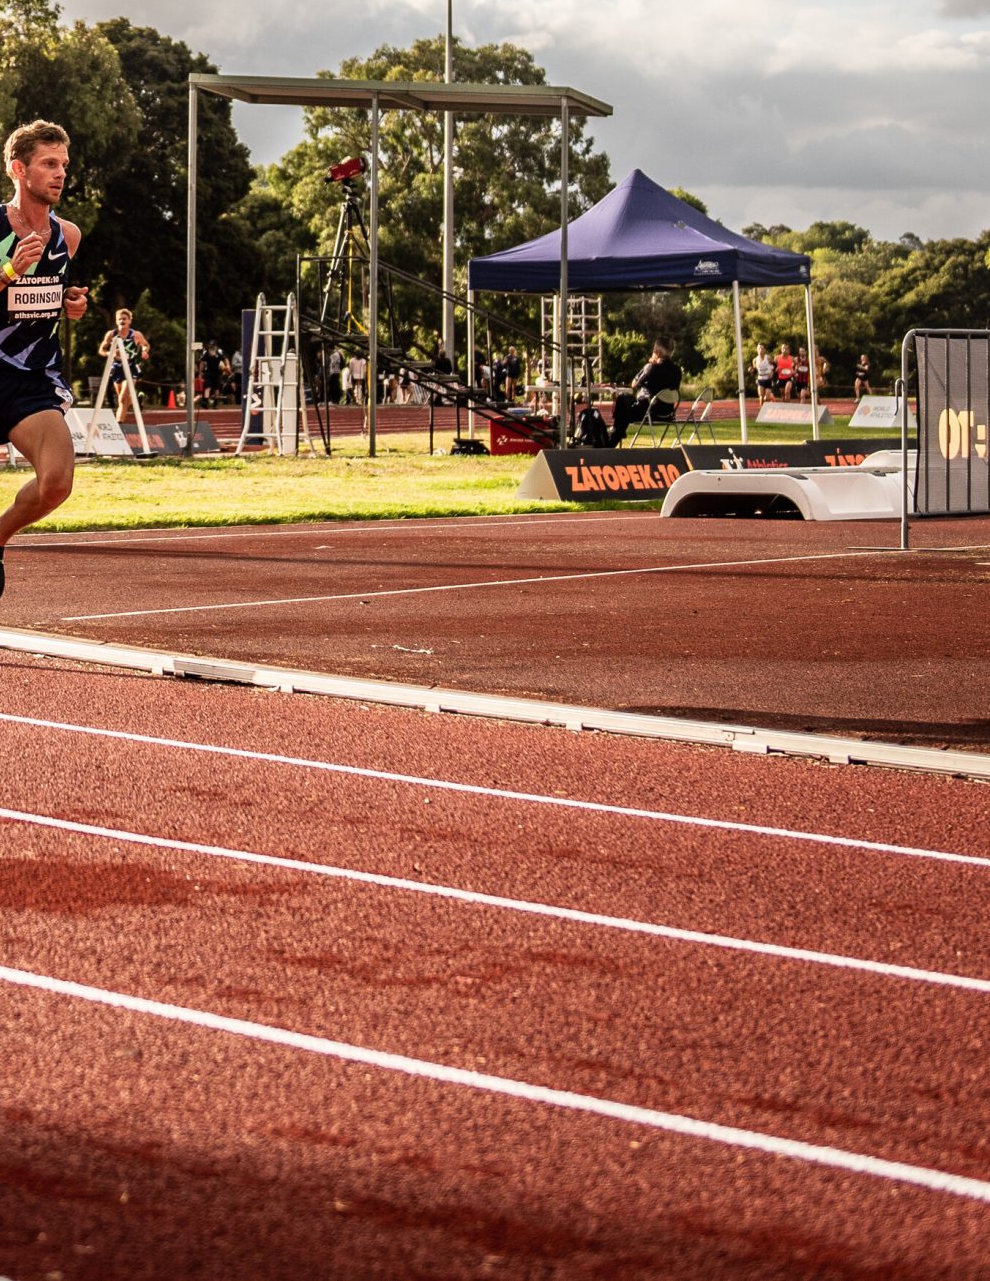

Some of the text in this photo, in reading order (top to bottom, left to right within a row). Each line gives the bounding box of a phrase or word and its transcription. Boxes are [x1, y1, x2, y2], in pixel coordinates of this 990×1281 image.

[14, 291, 61, 305] ROBINSON
[14, 311, 58, 319] athsvic.org.au
[565, 458, 681, 492] ZÁTOPEK:10
